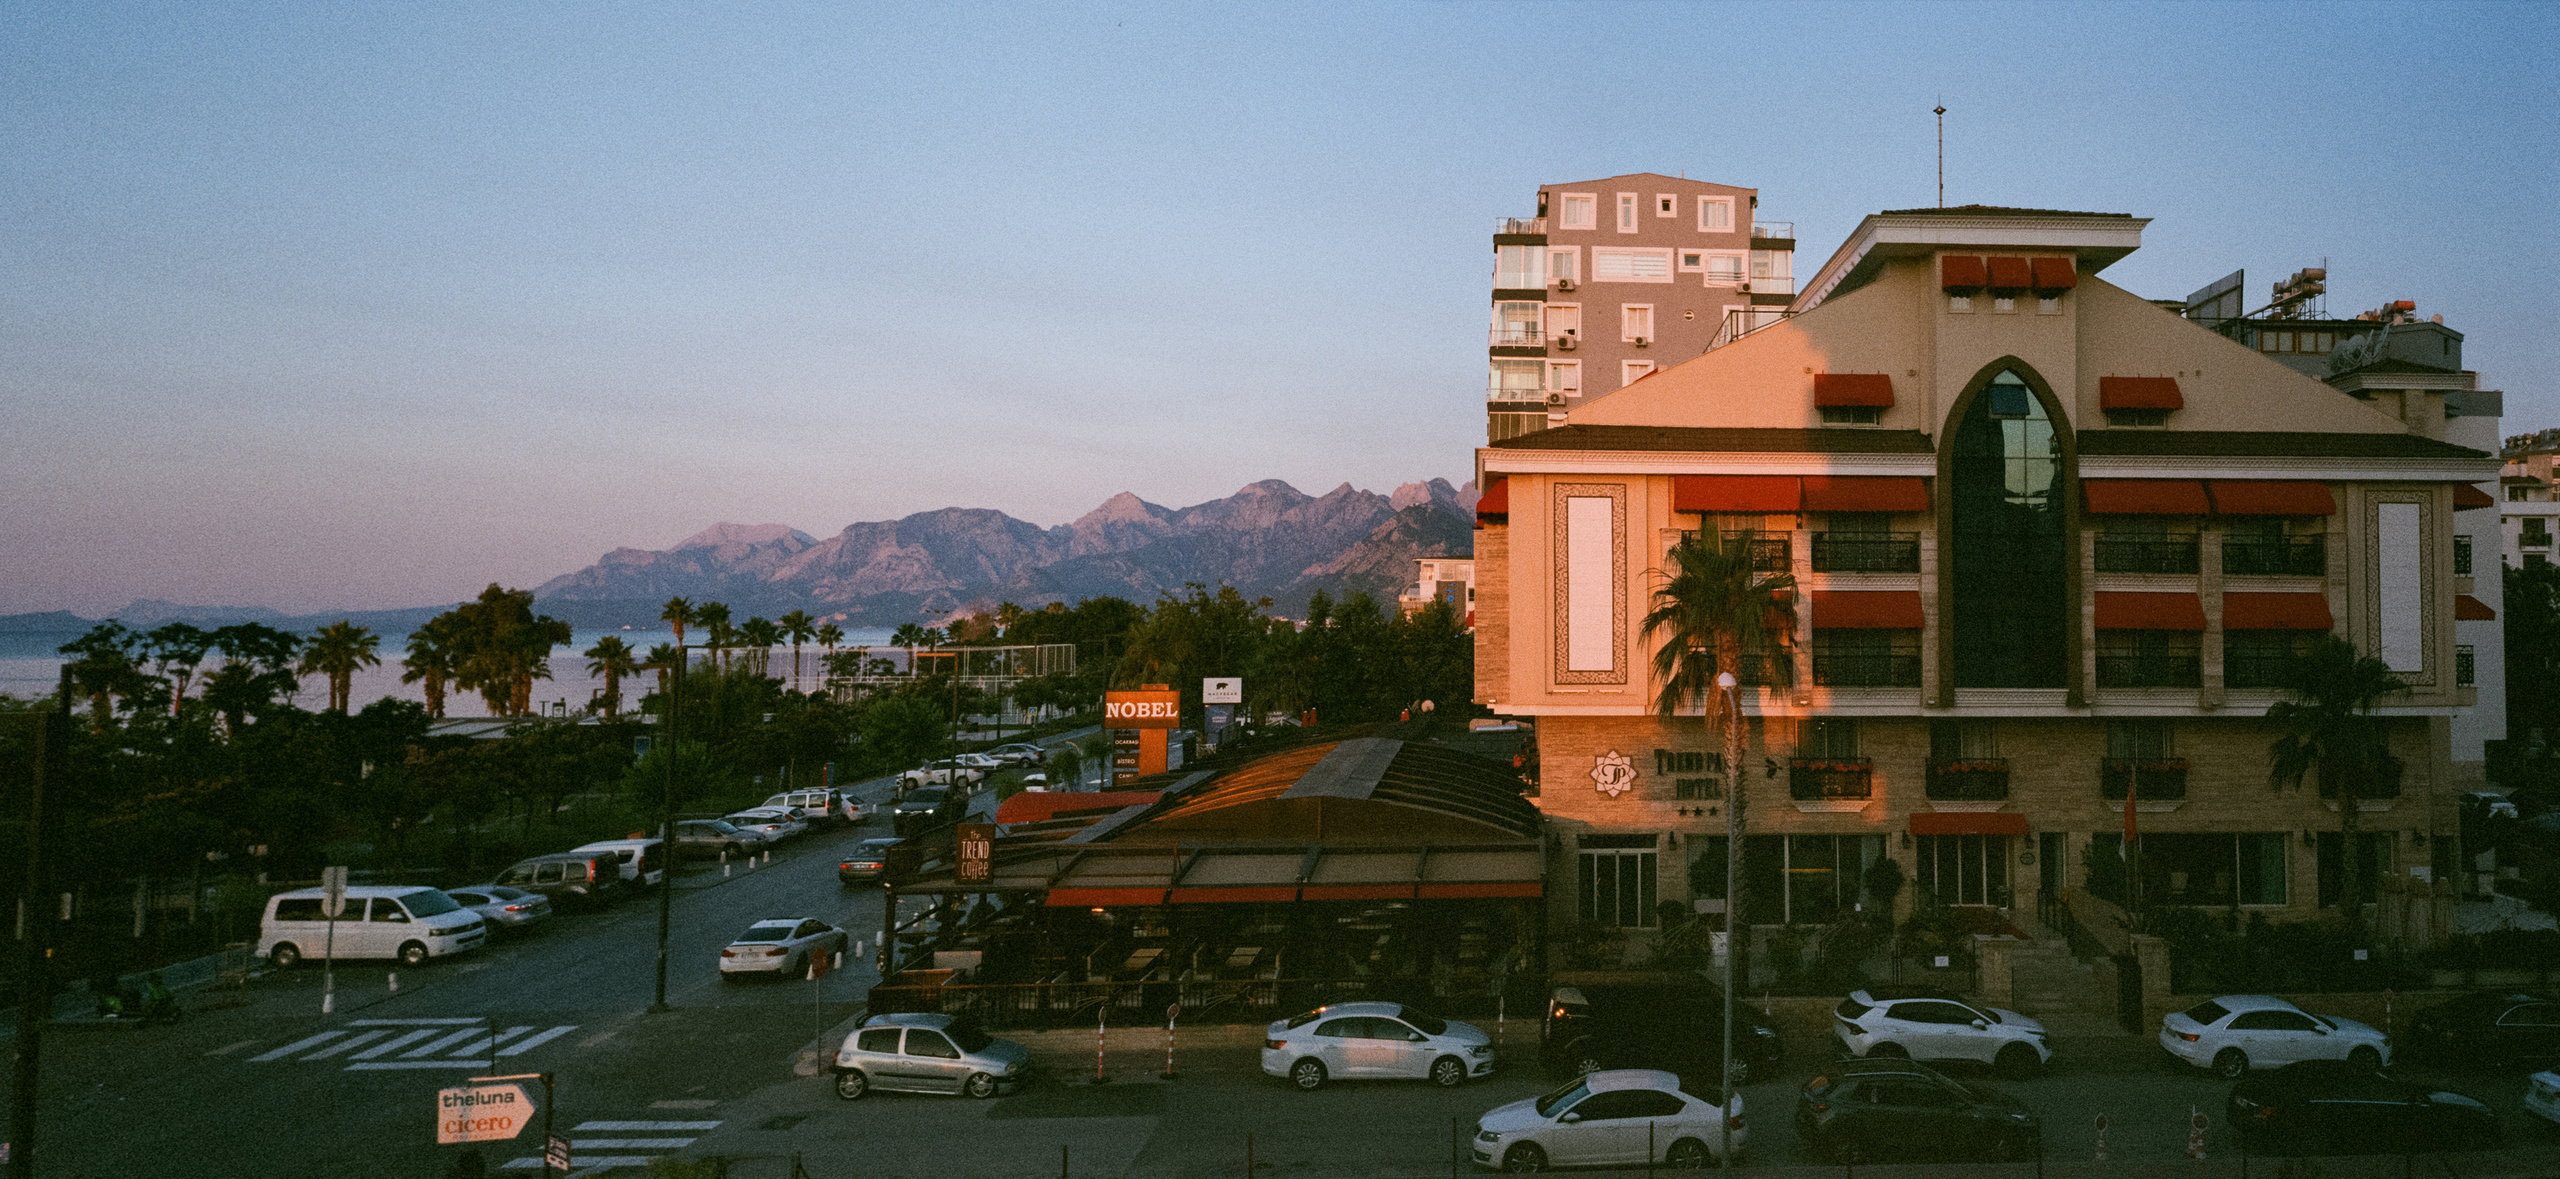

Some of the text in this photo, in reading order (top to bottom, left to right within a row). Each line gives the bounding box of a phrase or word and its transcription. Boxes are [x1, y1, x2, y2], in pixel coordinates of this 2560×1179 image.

[1106, 702, 1178, 718] NOBEL
[1676, 778, 1722, 800] HOTEL
[961, 841, 990, 859] TREND
[961, 861, 989, 880] coffee
[443, 1091, 515, 1107] theluna
[445, 1114, 512, 1134] cicero
